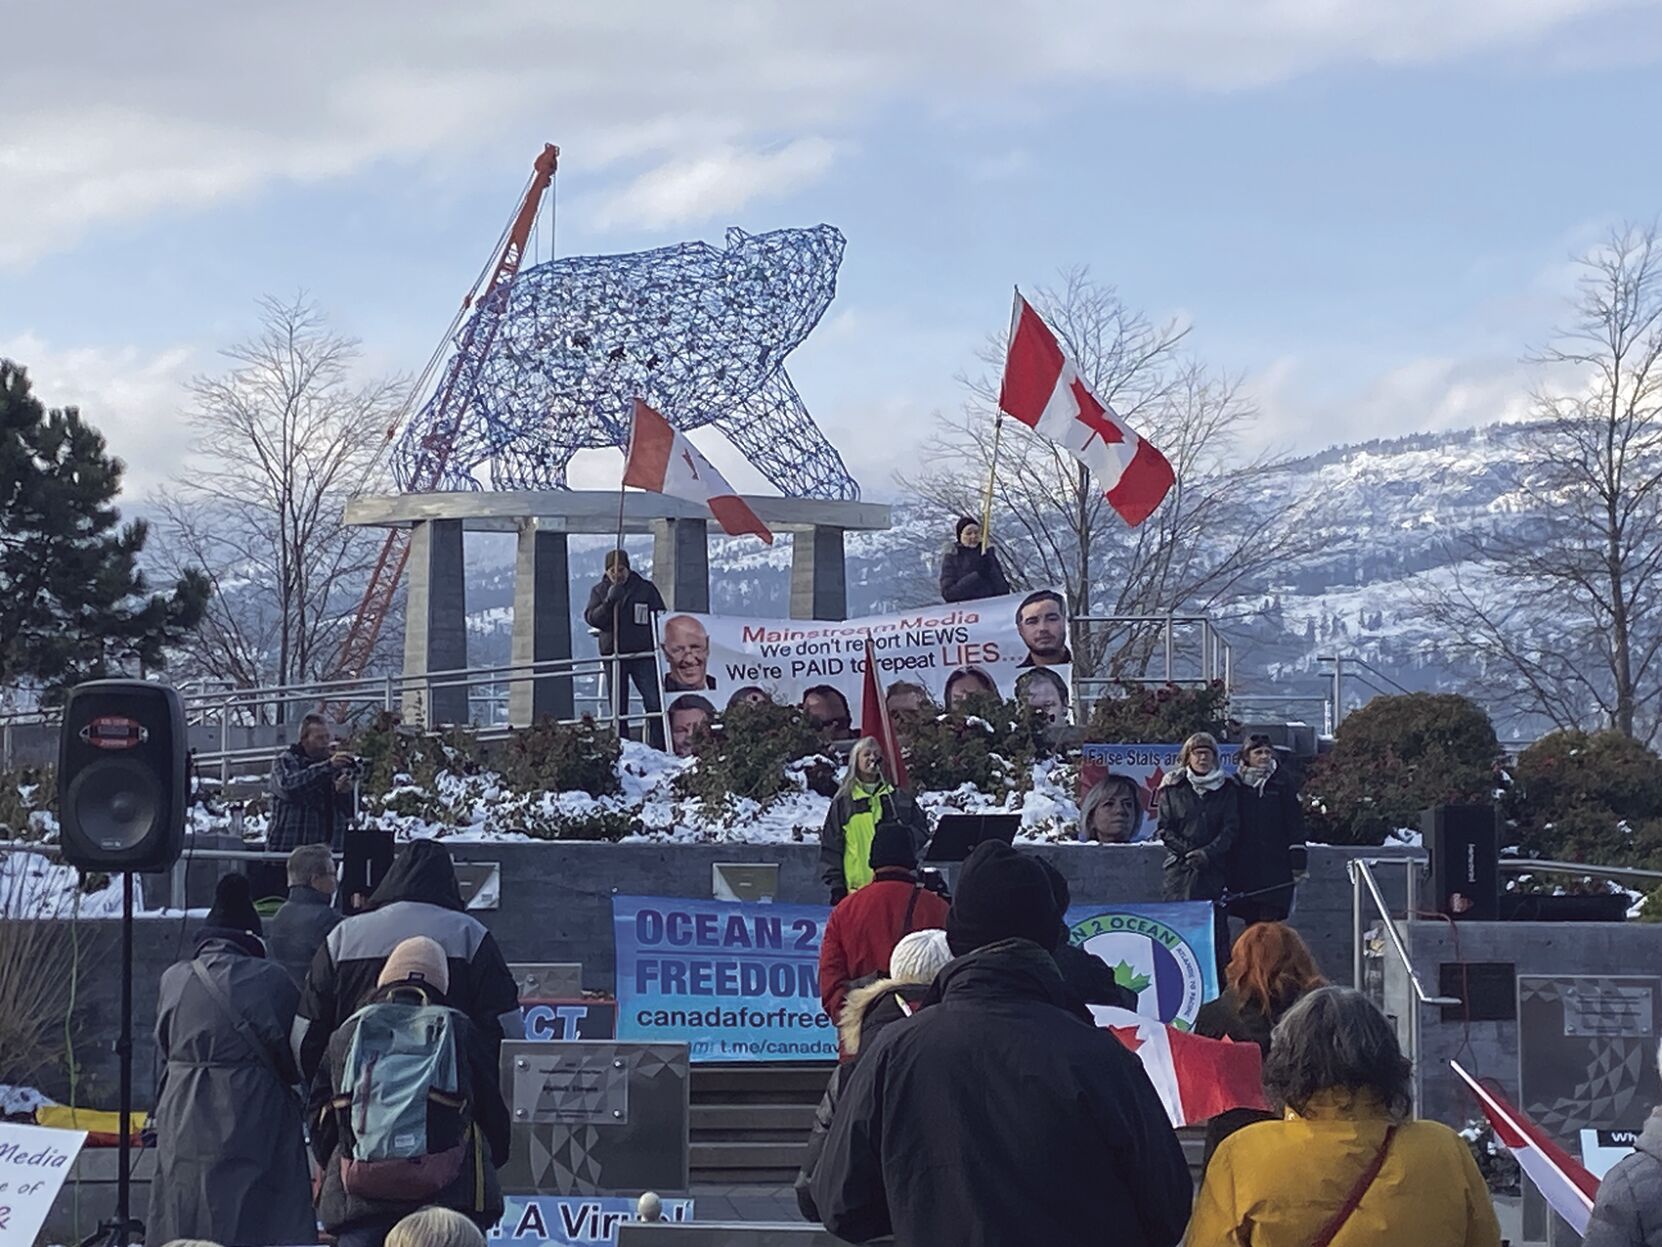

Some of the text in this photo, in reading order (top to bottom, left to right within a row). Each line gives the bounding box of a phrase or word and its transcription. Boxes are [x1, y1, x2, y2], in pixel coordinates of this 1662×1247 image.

[742, 611, 980, 643] Mainstream Media
[761, 627, 969, 658] We don't reort NEWS
[726, 663, 782, 681] We're
[792, 657, 843, 678] PAID
[1088, 749, 1122, 766] False
[1127, 749, 1160, 766] Stats
[636, 909, 819, 951] OCEAN 2
[1091, 920, 1103, 935] 2
[1110, 917, 1175, 945] OCEAN
[523, 1005, 588, 1040] CT
[637, 1007, 832, 1029] canadaforfree
[18, 1181, 45, 1195] of
[513, 1203, 548, 1239] A
